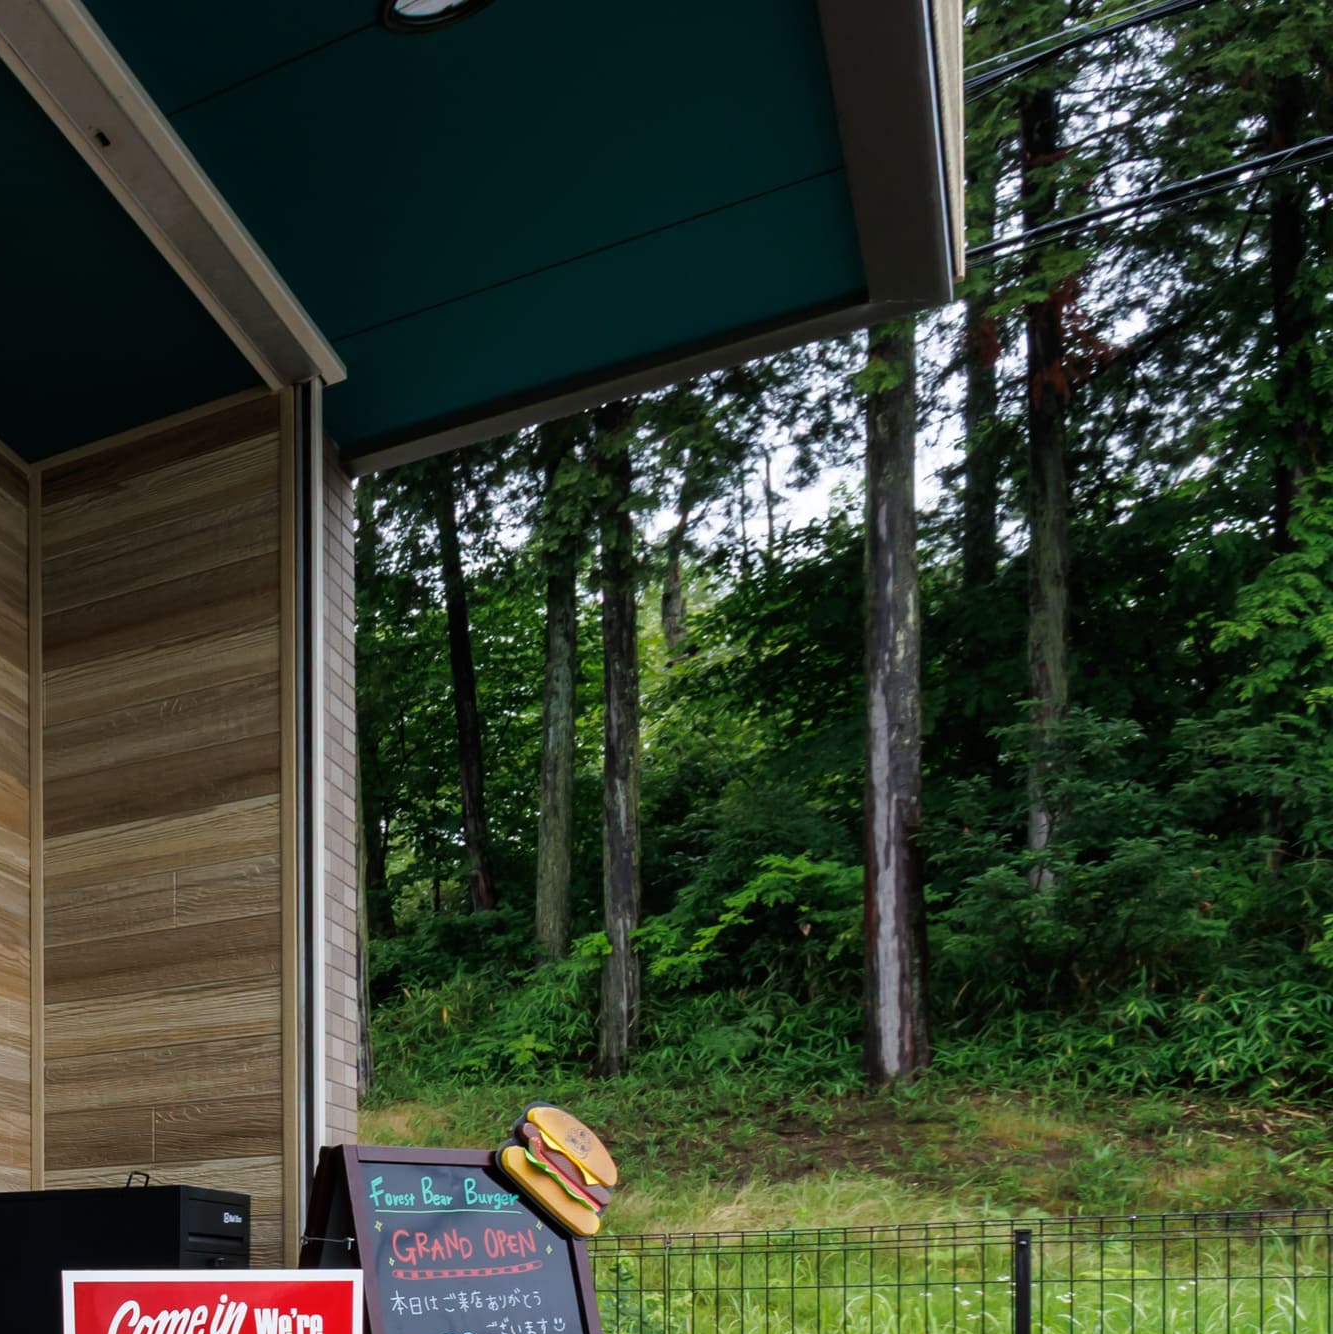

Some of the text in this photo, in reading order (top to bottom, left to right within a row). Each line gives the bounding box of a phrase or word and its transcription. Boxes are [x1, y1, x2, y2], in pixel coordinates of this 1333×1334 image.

[368, 1175, 520, 1210] Forest Bear Burger
[392, 1227, 538, 1266] GRAND OPEN
